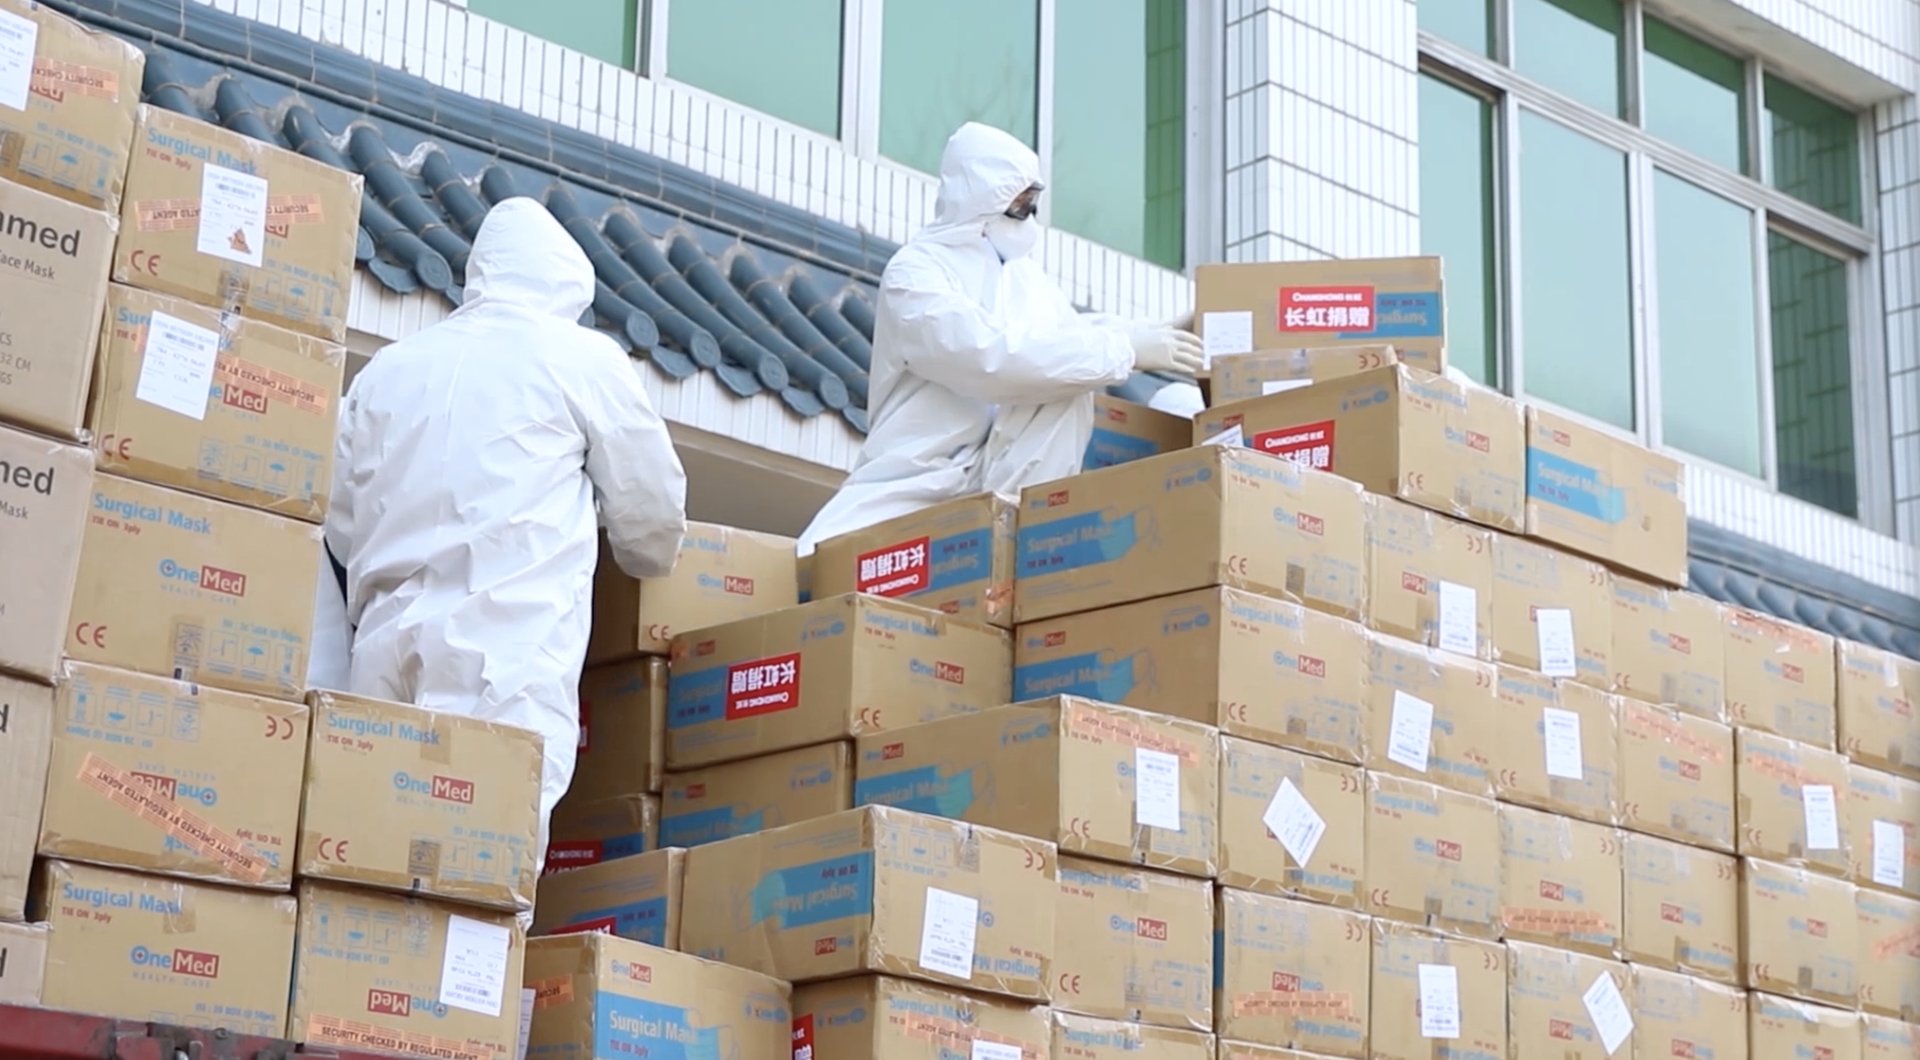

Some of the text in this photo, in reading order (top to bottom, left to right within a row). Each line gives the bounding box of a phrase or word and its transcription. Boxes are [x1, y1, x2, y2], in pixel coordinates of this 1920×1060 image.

[148, 127, 211, 160] Surgical
[152, 209, 179, 219] AGENT
[24, 259, 55, 280] Mask
[1284, 307, 1370, 328] 长虹捐赠
[15, 356, 31, 372] CM
[278, 383, 314, 402] SECURITY
[94, 492, 213, 535] Surgical Mask
[861, 543, 926, 581] 长虹捐赠
[731, 659, 796, 695] 长虹捐赠
[327, 712, 440, 745] Surgical Mask
[97, 771, 253, 869] SECURITY CHECKED BY REGULATED AGENT
[63, 883, 134, 908] Surgical
[609, 1010, 662, 1040] Surgical
[322, 1026, 358, 1042] SECURITY
[361, 1035, 396, 1049] CHECKED
[398, 1040, 408, 1050] BY
[410, 1042, 453, 1058] REGULATED
